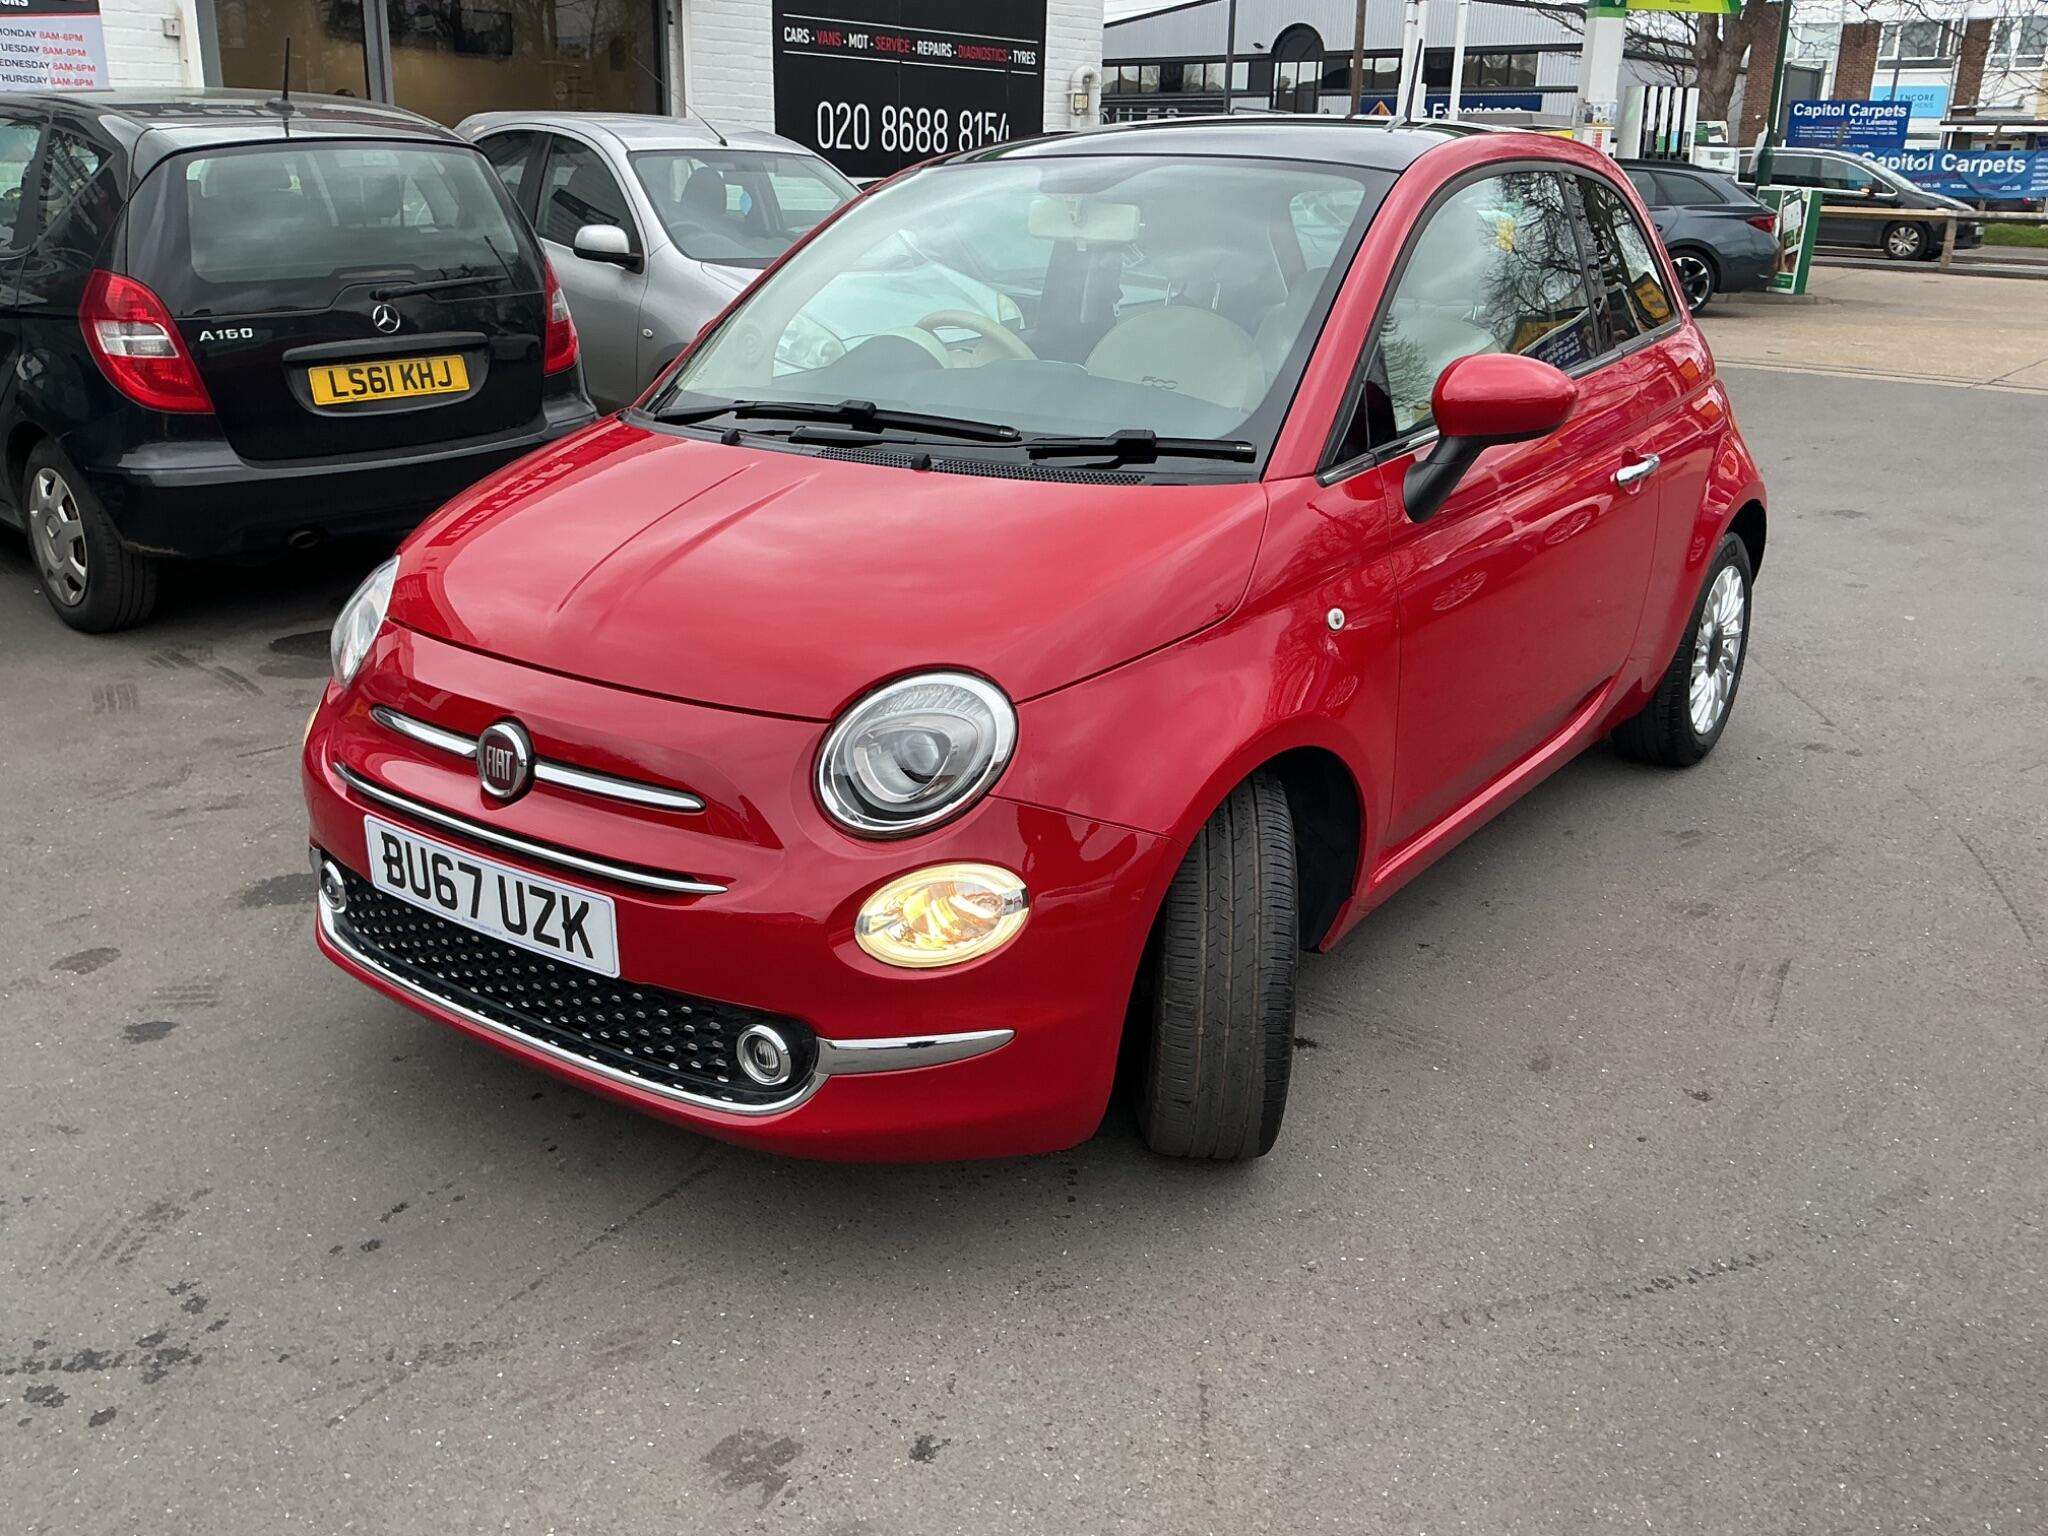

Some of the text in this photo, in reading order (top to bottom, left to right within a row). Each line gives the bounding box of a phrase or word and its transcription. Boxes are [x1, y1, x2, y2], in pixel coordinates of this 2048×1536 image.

[0, 43, 40, 54] UESDAY
[783, 27, 1037, 65] CARS VANS MOT SERVICE REPAIRS DIAGNOSTICS TYRES
[0, 58, 50, 70] EDNESDAY
[1793, 103, 1907, 120] Capitol Carpets
[816, 100, 1011, 154] 020 8688 8154
[1940, 153, 2027, 177] Carpets
[199, 327, 254, 342] A160
[328, 360, 453, 398] LS61 KHJ
[486, 745, 514, 781] FIAT
[380, 830, 595, 960] BU67 UZK
